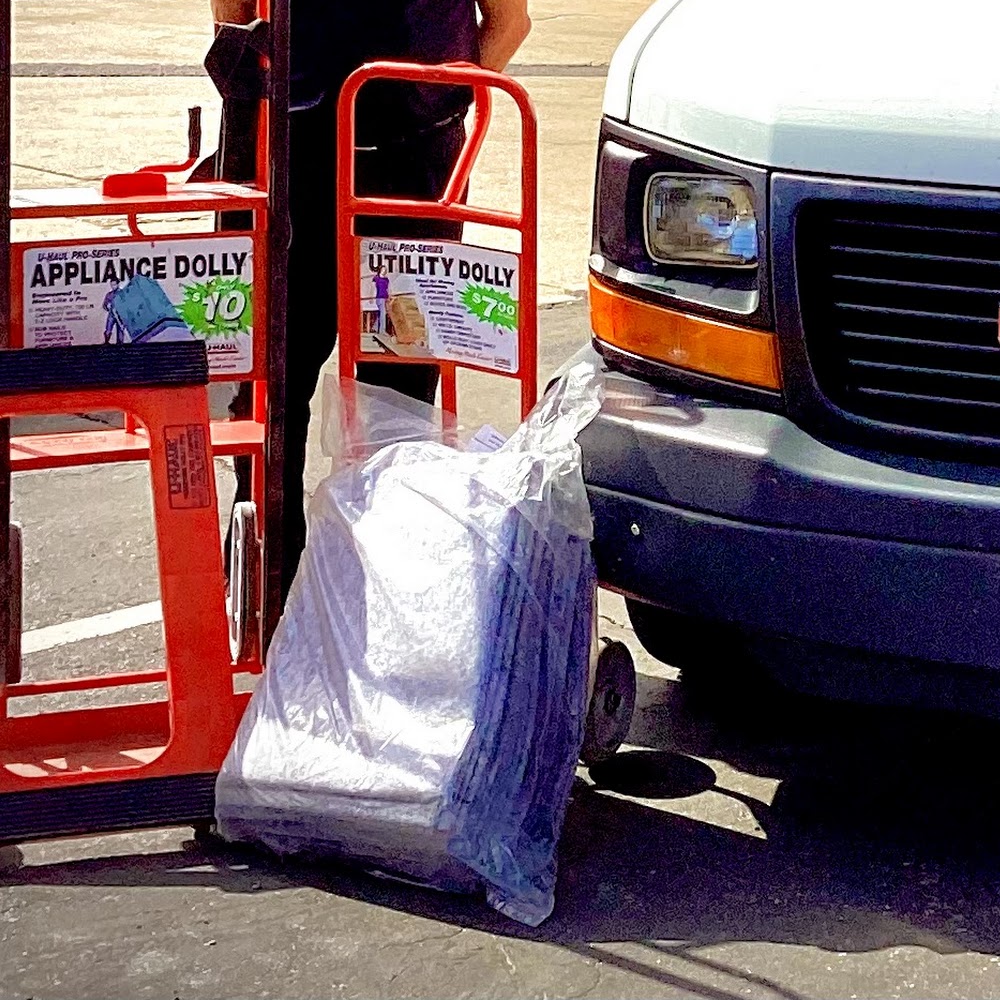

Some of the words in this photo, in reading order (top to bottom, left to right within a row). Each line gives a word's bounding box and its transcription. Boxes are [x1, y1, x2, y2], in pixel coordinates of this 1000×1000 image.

[30, 256, 167, 288] APPLIANCE
[174, 252, 248, 279] DOLLY
[369, 253, 455, 277] UTILITY
[458, 259, 515, 288] DOLLY
